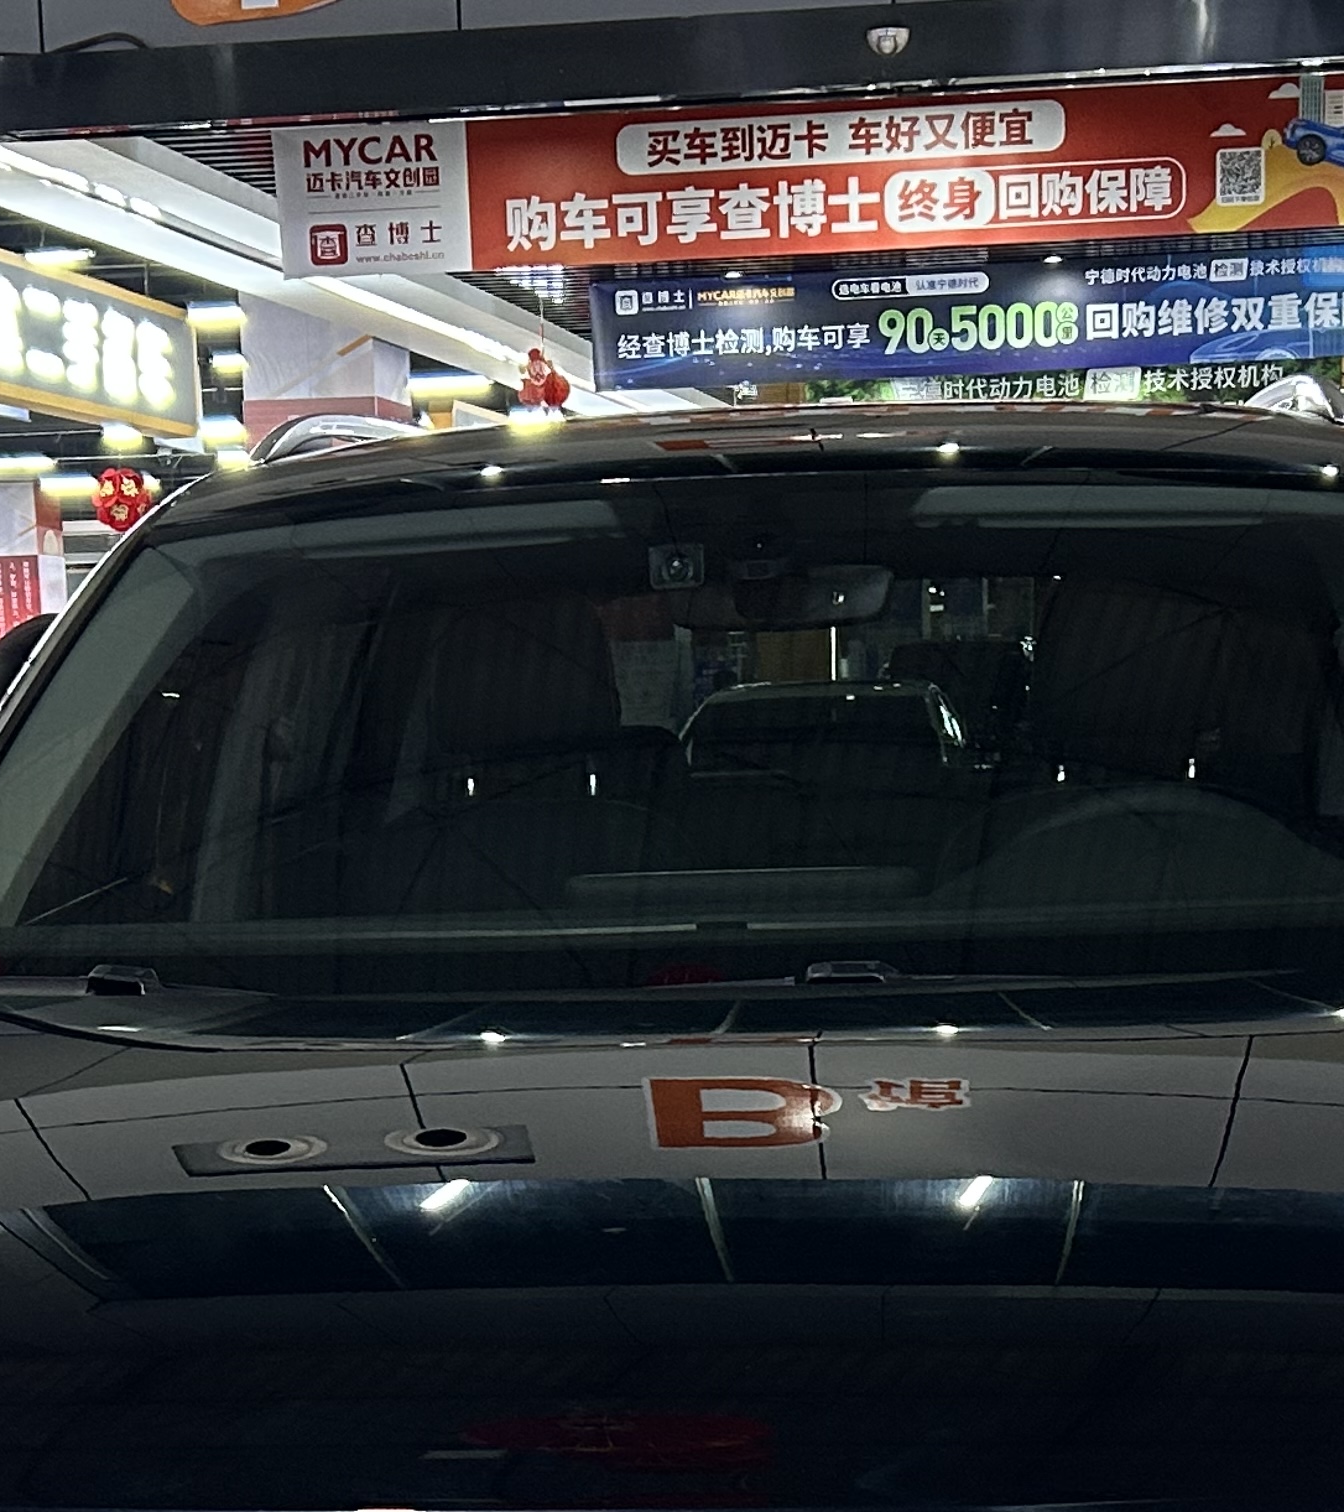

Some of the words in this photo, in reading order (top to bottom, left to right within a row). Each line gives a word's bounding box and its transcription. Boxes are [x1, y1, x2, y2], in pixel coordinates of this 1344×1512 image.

[303, 133, 438, 168] MYCAR
[646, 120, 829, 168] 买车到迈卡
[848, 107, 1034, 154] 车好又便宜
[306, 166, 440, 193] 迈卡汽车文创园
[355, 220, 443, 247] 查博士
